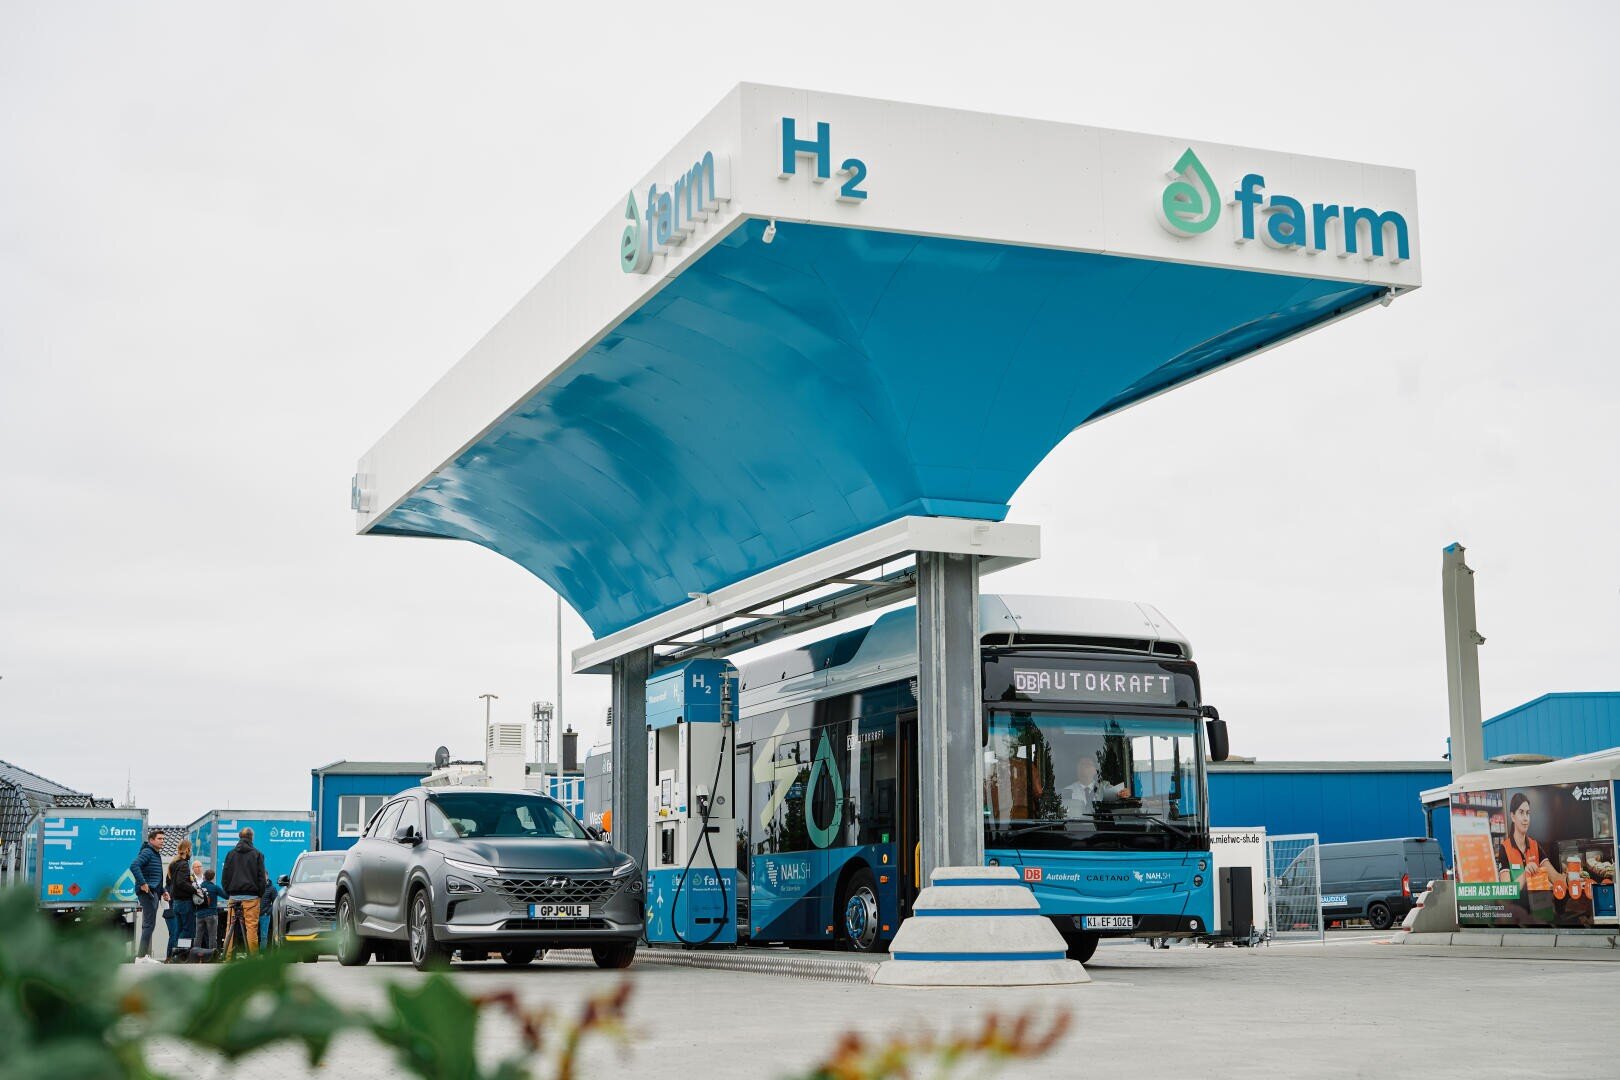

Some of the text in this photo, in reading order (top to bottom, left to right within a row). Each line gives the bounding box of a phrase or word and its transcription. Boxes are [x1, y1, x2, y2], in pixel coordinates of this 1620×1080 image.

[1015, 671, 1170, 694] DB AUTOKRAFT
[1582, 786, 1609, 796] team
[110, 826, 136, 836] farm
[280, 828, 305, 838] farm
[781, 862, 811, 880] NAH.SH
[1025, 869, 1041, 880] DB
[1046, 873, 1080, 882] Autokraft
[1145, 872, 1171, 880] NAH.SH
[1457, 884, 1518, 897] MEHR ALS TANKEN
[540, 905, 582, 916] GP JOULE
[1087, 916, 1132, 927] KI EF 102E
